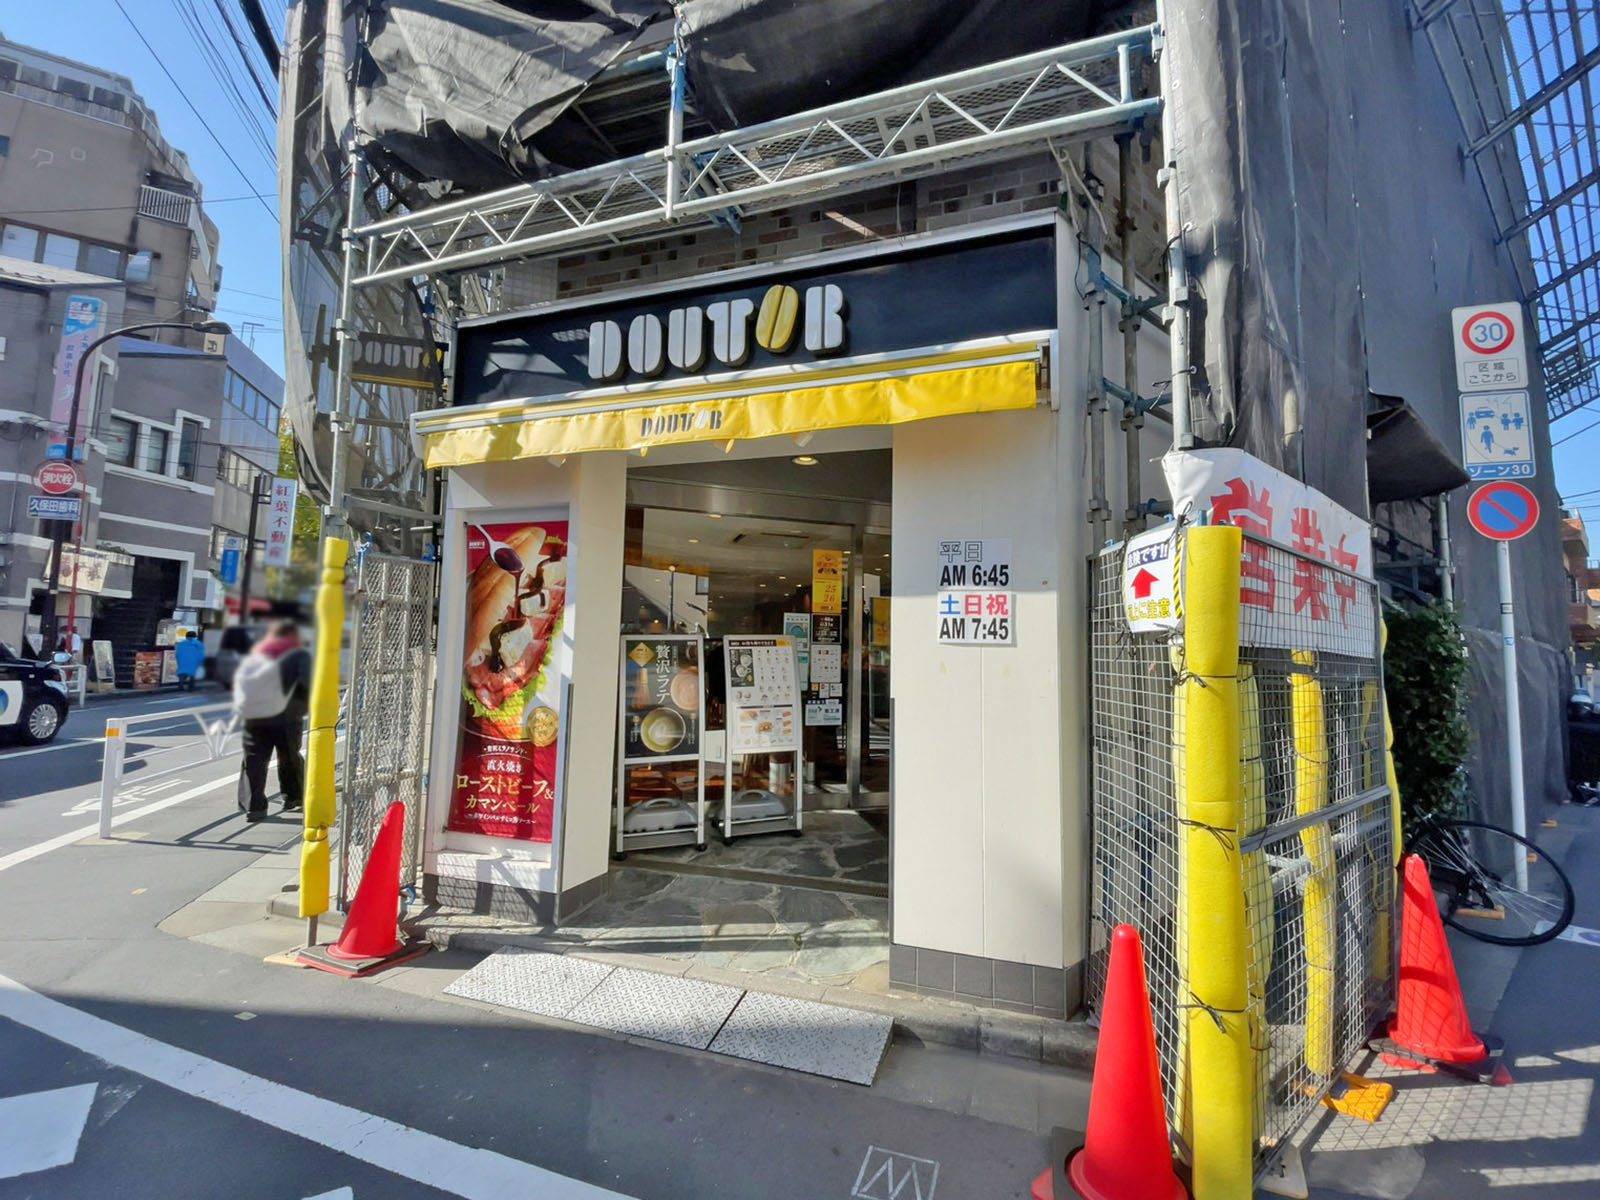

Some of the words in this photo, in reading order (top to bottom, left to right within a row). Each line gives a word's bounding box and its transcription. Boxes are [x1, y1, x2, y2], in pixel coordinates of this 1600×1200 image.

[587, 284, 844, 381] DOUTOR
[1474, 322, 1503, 343] 30
[1478, 361, 1506, 373] 区域
[1468, 372, 1517, 385] ここから
[641, 409, 723, 437] DOUTOR
[42, 472, 74, 485] 消火栓
[30, 499, 79, 513] 久保田歯科
[940, 541, 983, 563] 平日
[1210, 477, 1359, 630] 営業中
[940, 564, 966, 587] AM
[972, 564, 1009, 587] 6:45
[940, 594, 1009, 616] 土日祝
[940, 618, 966, 640] AM
[971, 618, 1009, 640] 7:45
[655, 645, 671, 705] 贅沢ラテ
[487, 760, 522, 774] 直火焼き
[465, 794, 540, 814] カマンベール
